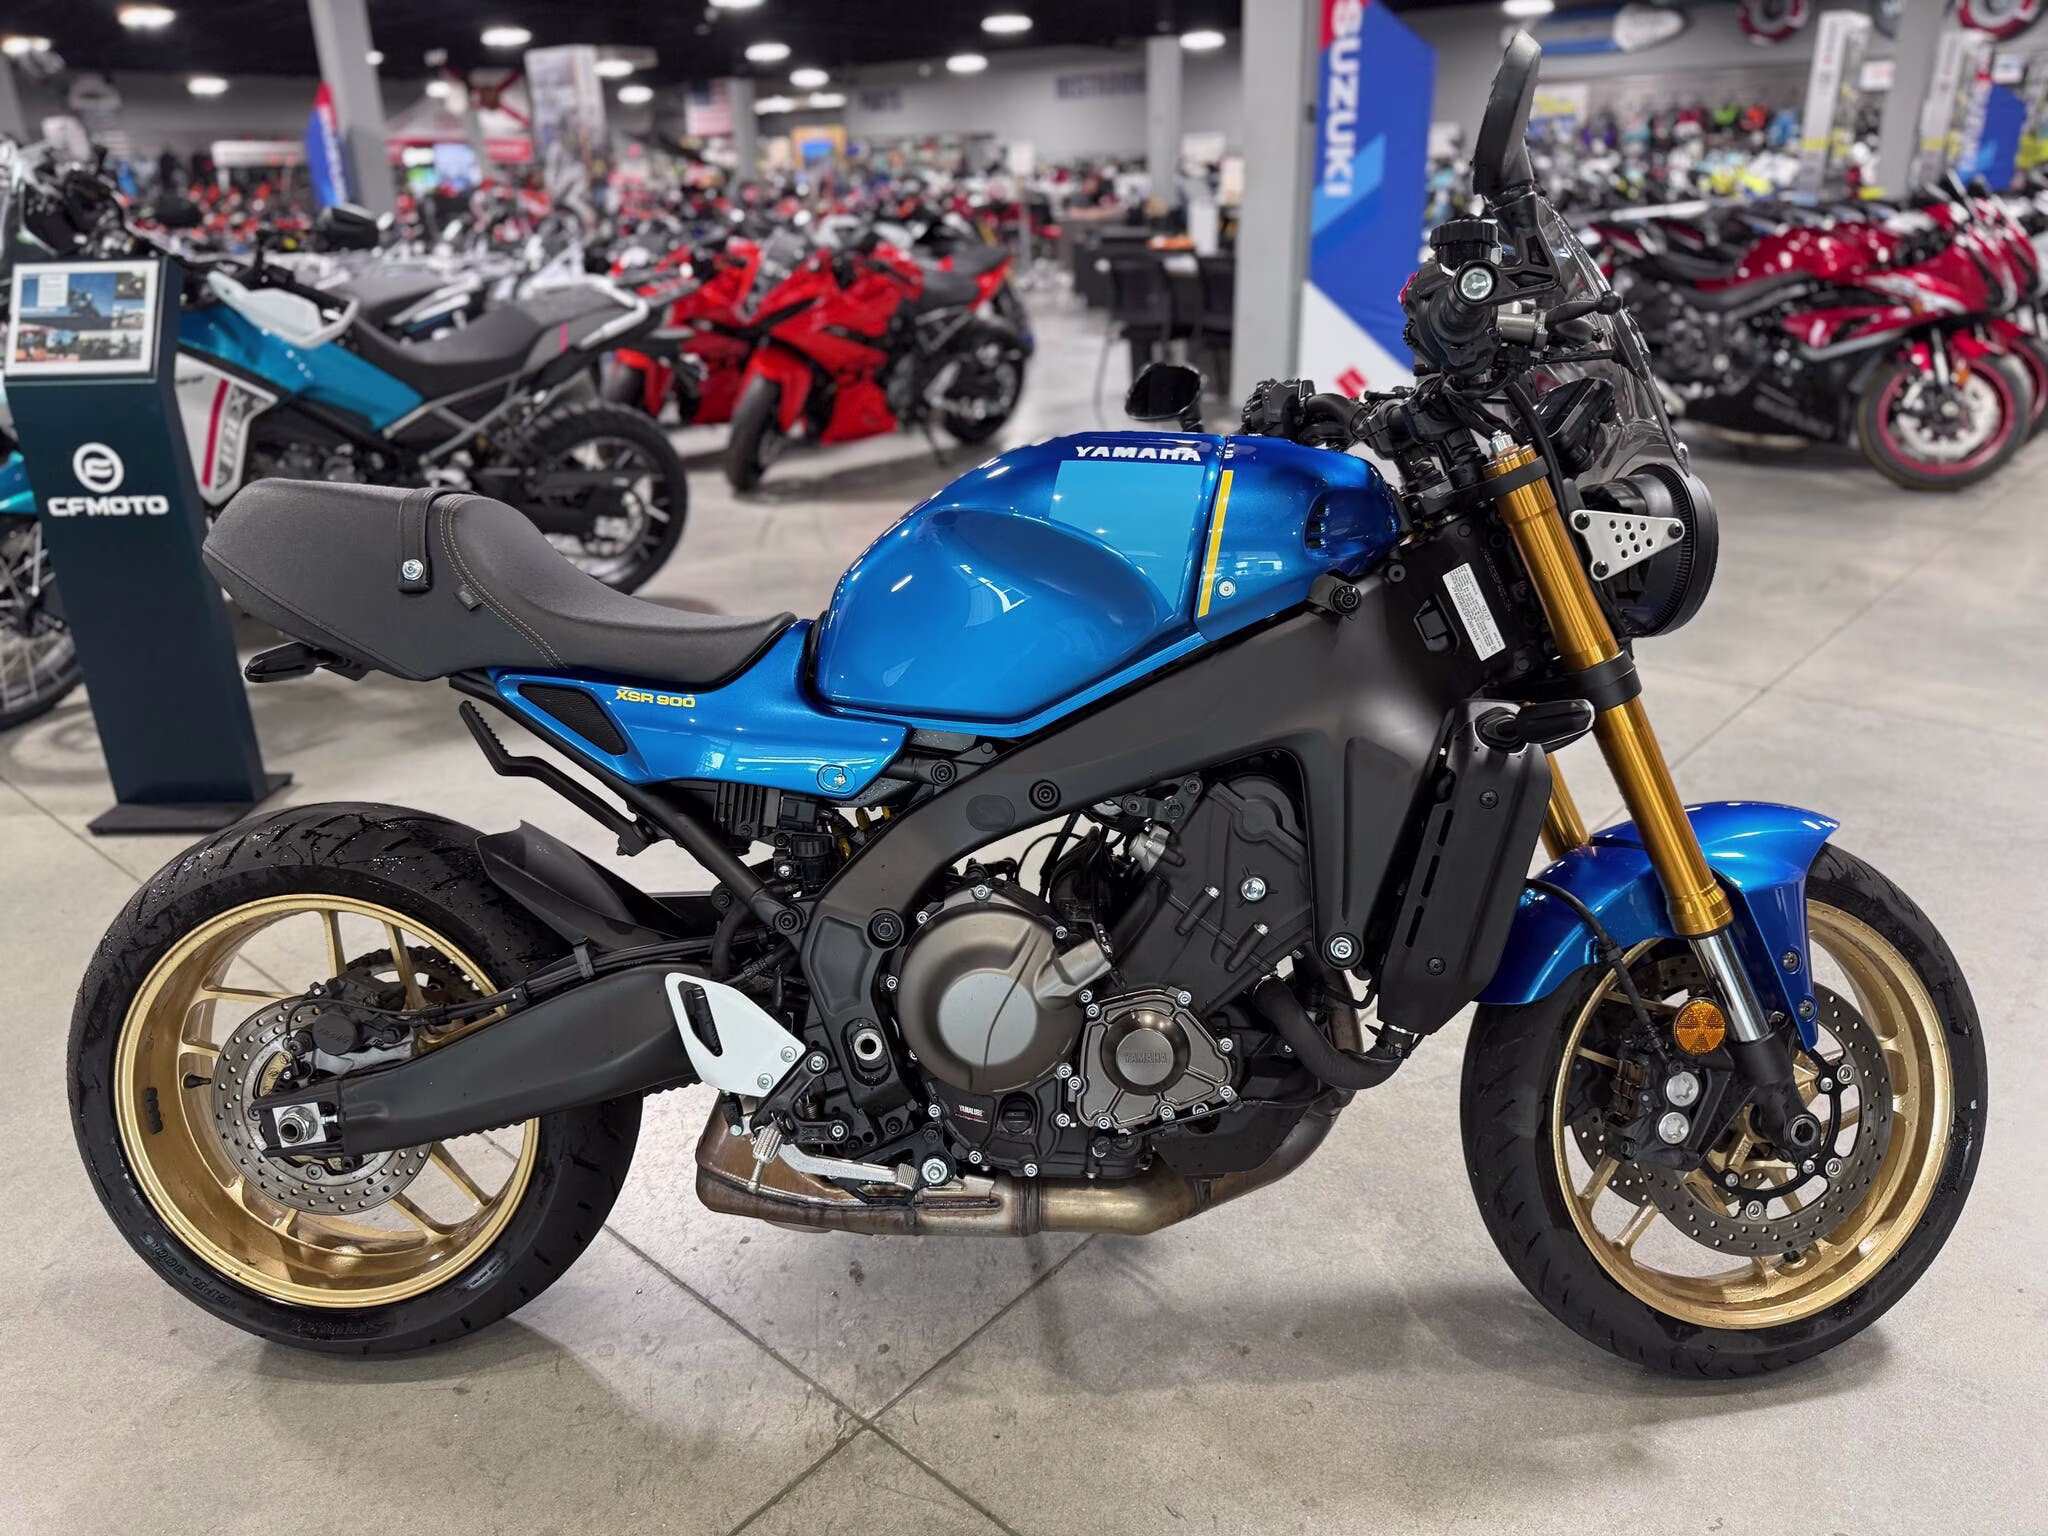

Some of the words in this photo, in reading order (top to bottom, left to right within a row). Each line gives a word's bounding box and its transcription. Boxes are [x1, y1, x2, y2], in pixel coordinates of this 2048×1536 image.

[1323, 0, 1363, 197] SUZUKI
[1075, 446, 1201, 462] YAMAHA
[47, 495, 169, 517] CFMOTO
[614, 689, 655, 704] XSR
[656, 695, 696, 708] 900
[1123, 1050, 1168, 1065] YAMAHA
